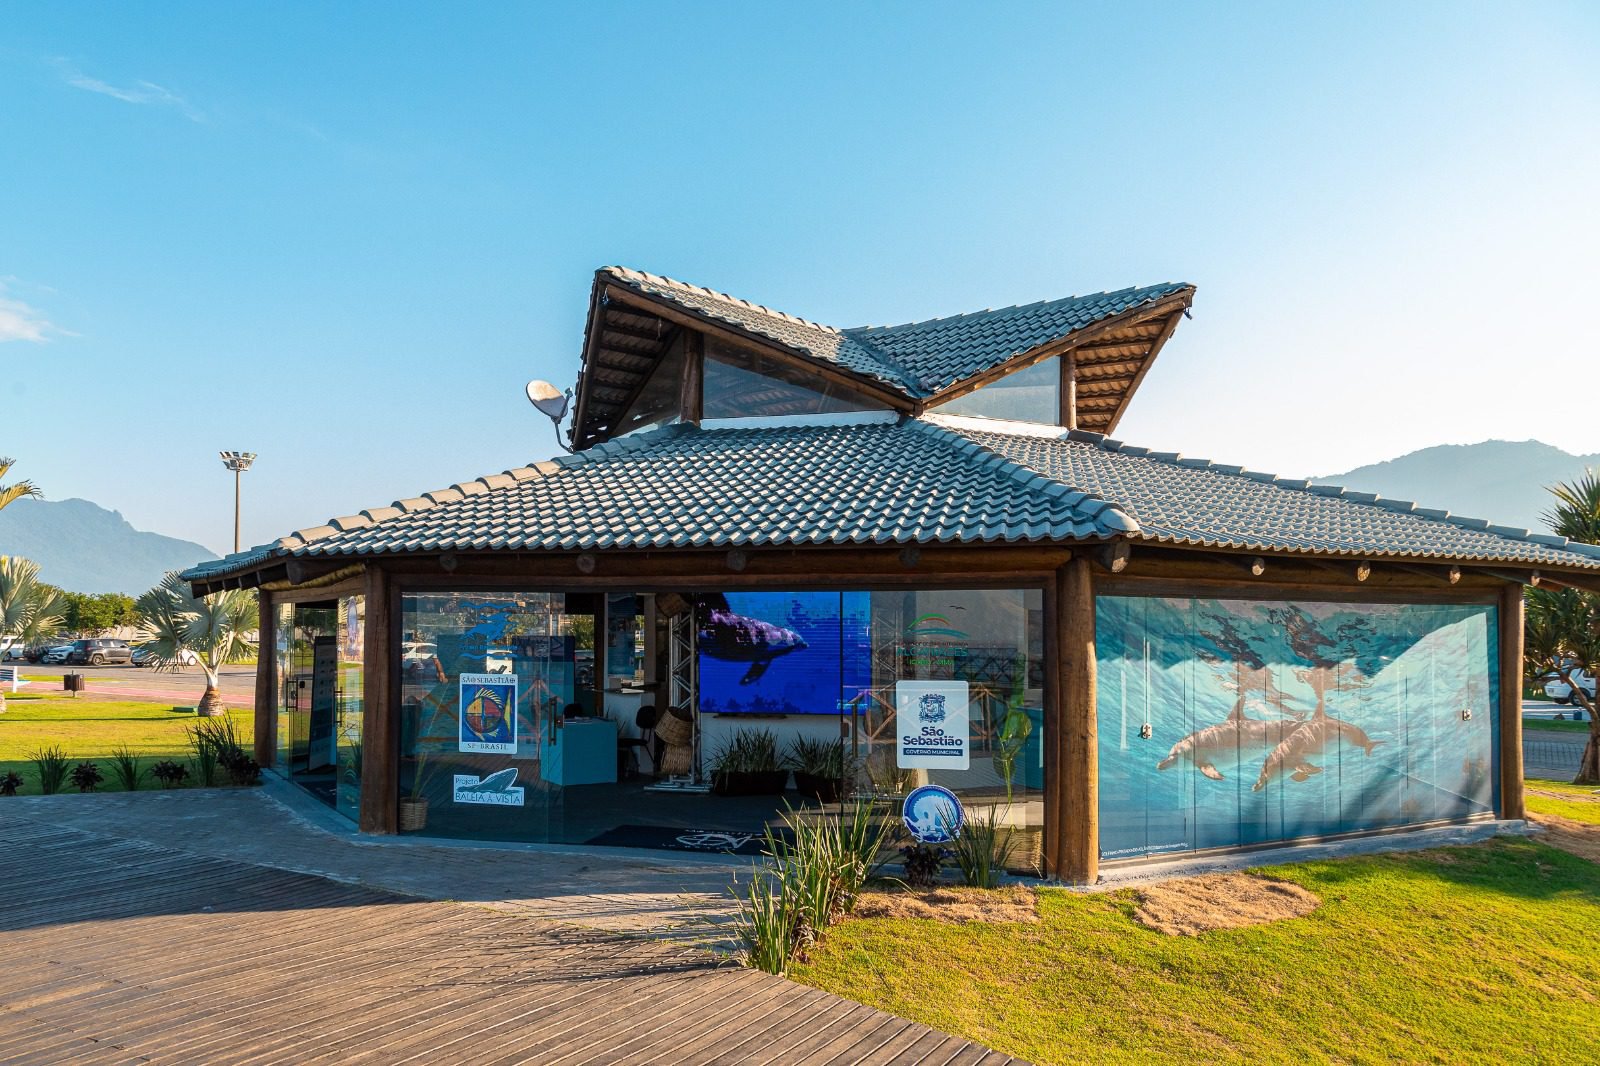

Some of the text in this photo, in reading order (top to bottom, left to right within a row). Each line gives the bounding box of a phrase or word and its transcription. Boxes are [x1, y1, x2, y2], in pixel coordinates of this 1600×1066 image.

[921, 726, 944, 736] São
[903, 735, 963, 746] Sebastião
[455, 778, 478, 786] Projeto
[455, 792, 484, 802] BALEIA
